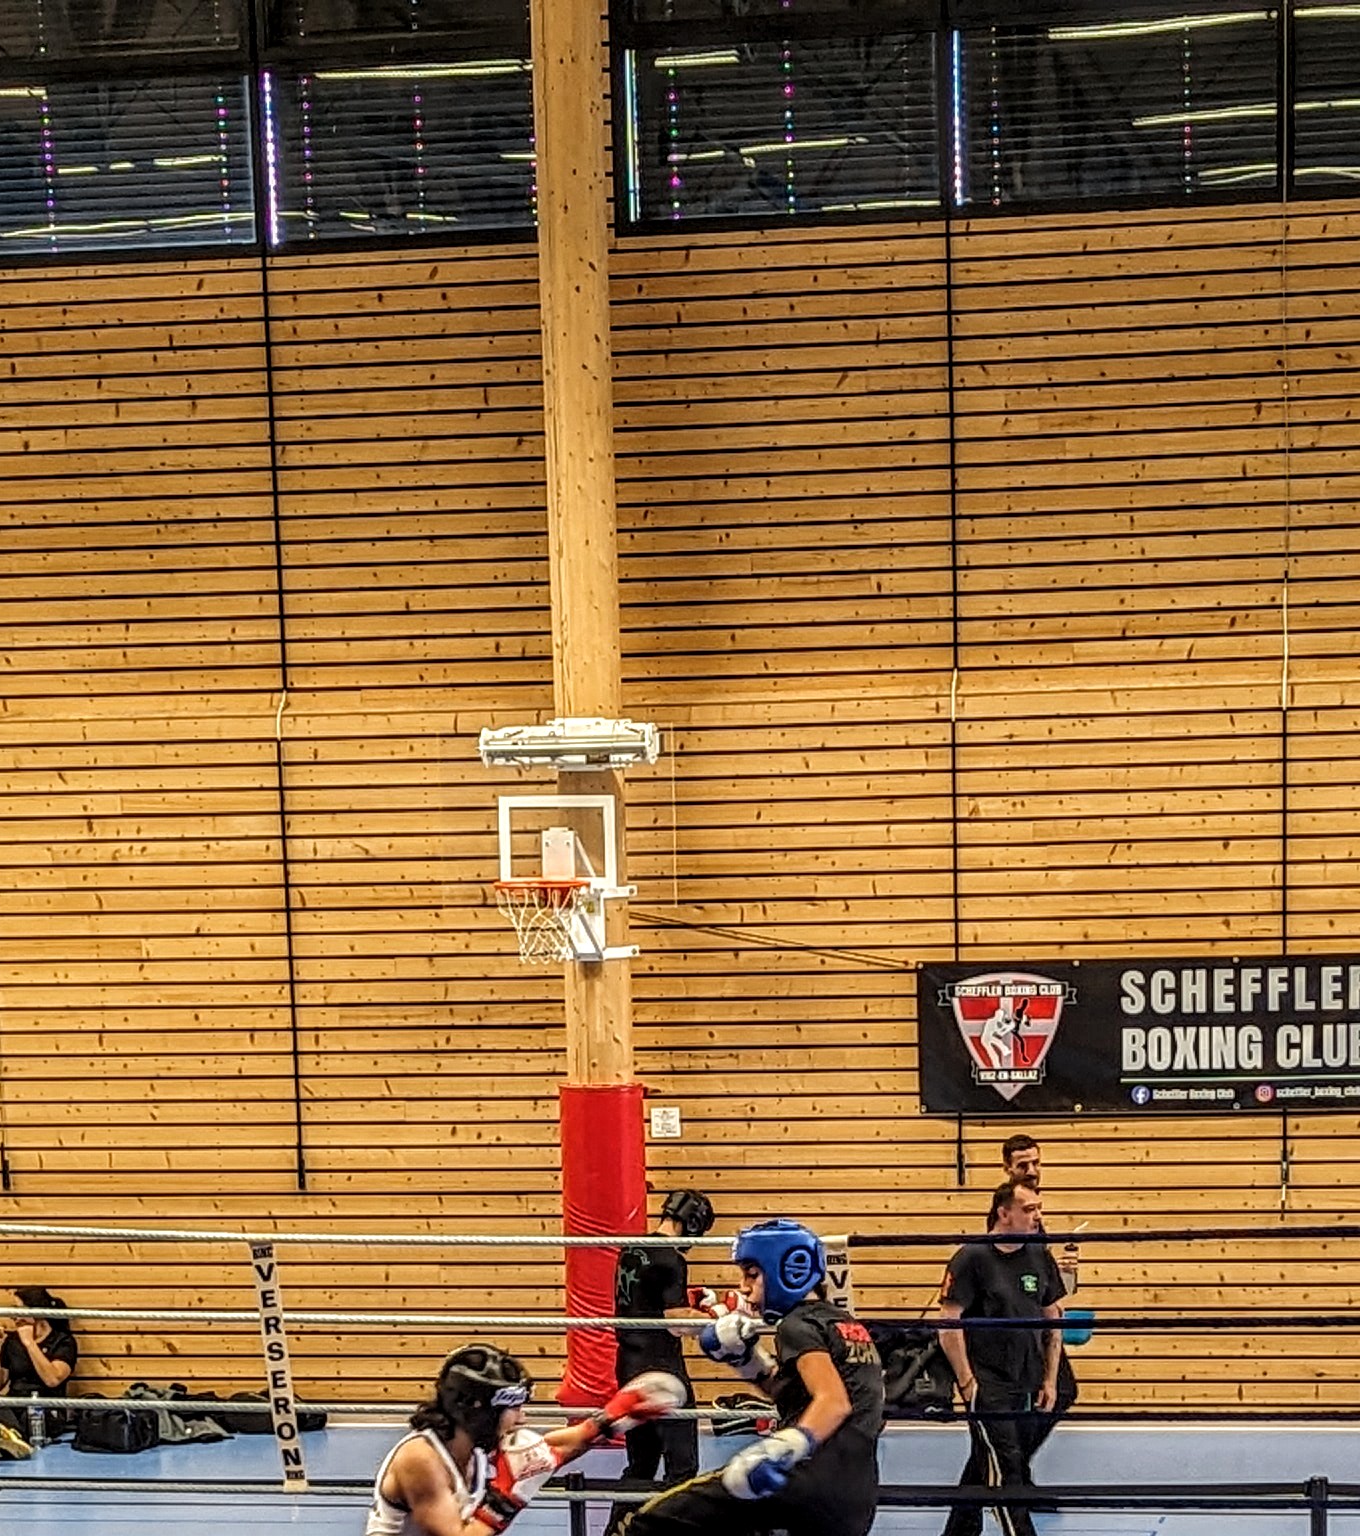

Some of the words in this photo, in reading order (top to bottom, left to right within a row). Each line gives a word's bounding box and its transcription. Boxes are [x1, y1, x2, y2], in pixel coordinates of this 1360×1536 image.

[954, 985, 1002, 997] SCHEFFLER
[1121, 1025, 1263, 1071] BOXING
[254, 1262, 302, 1466] VERSERON
